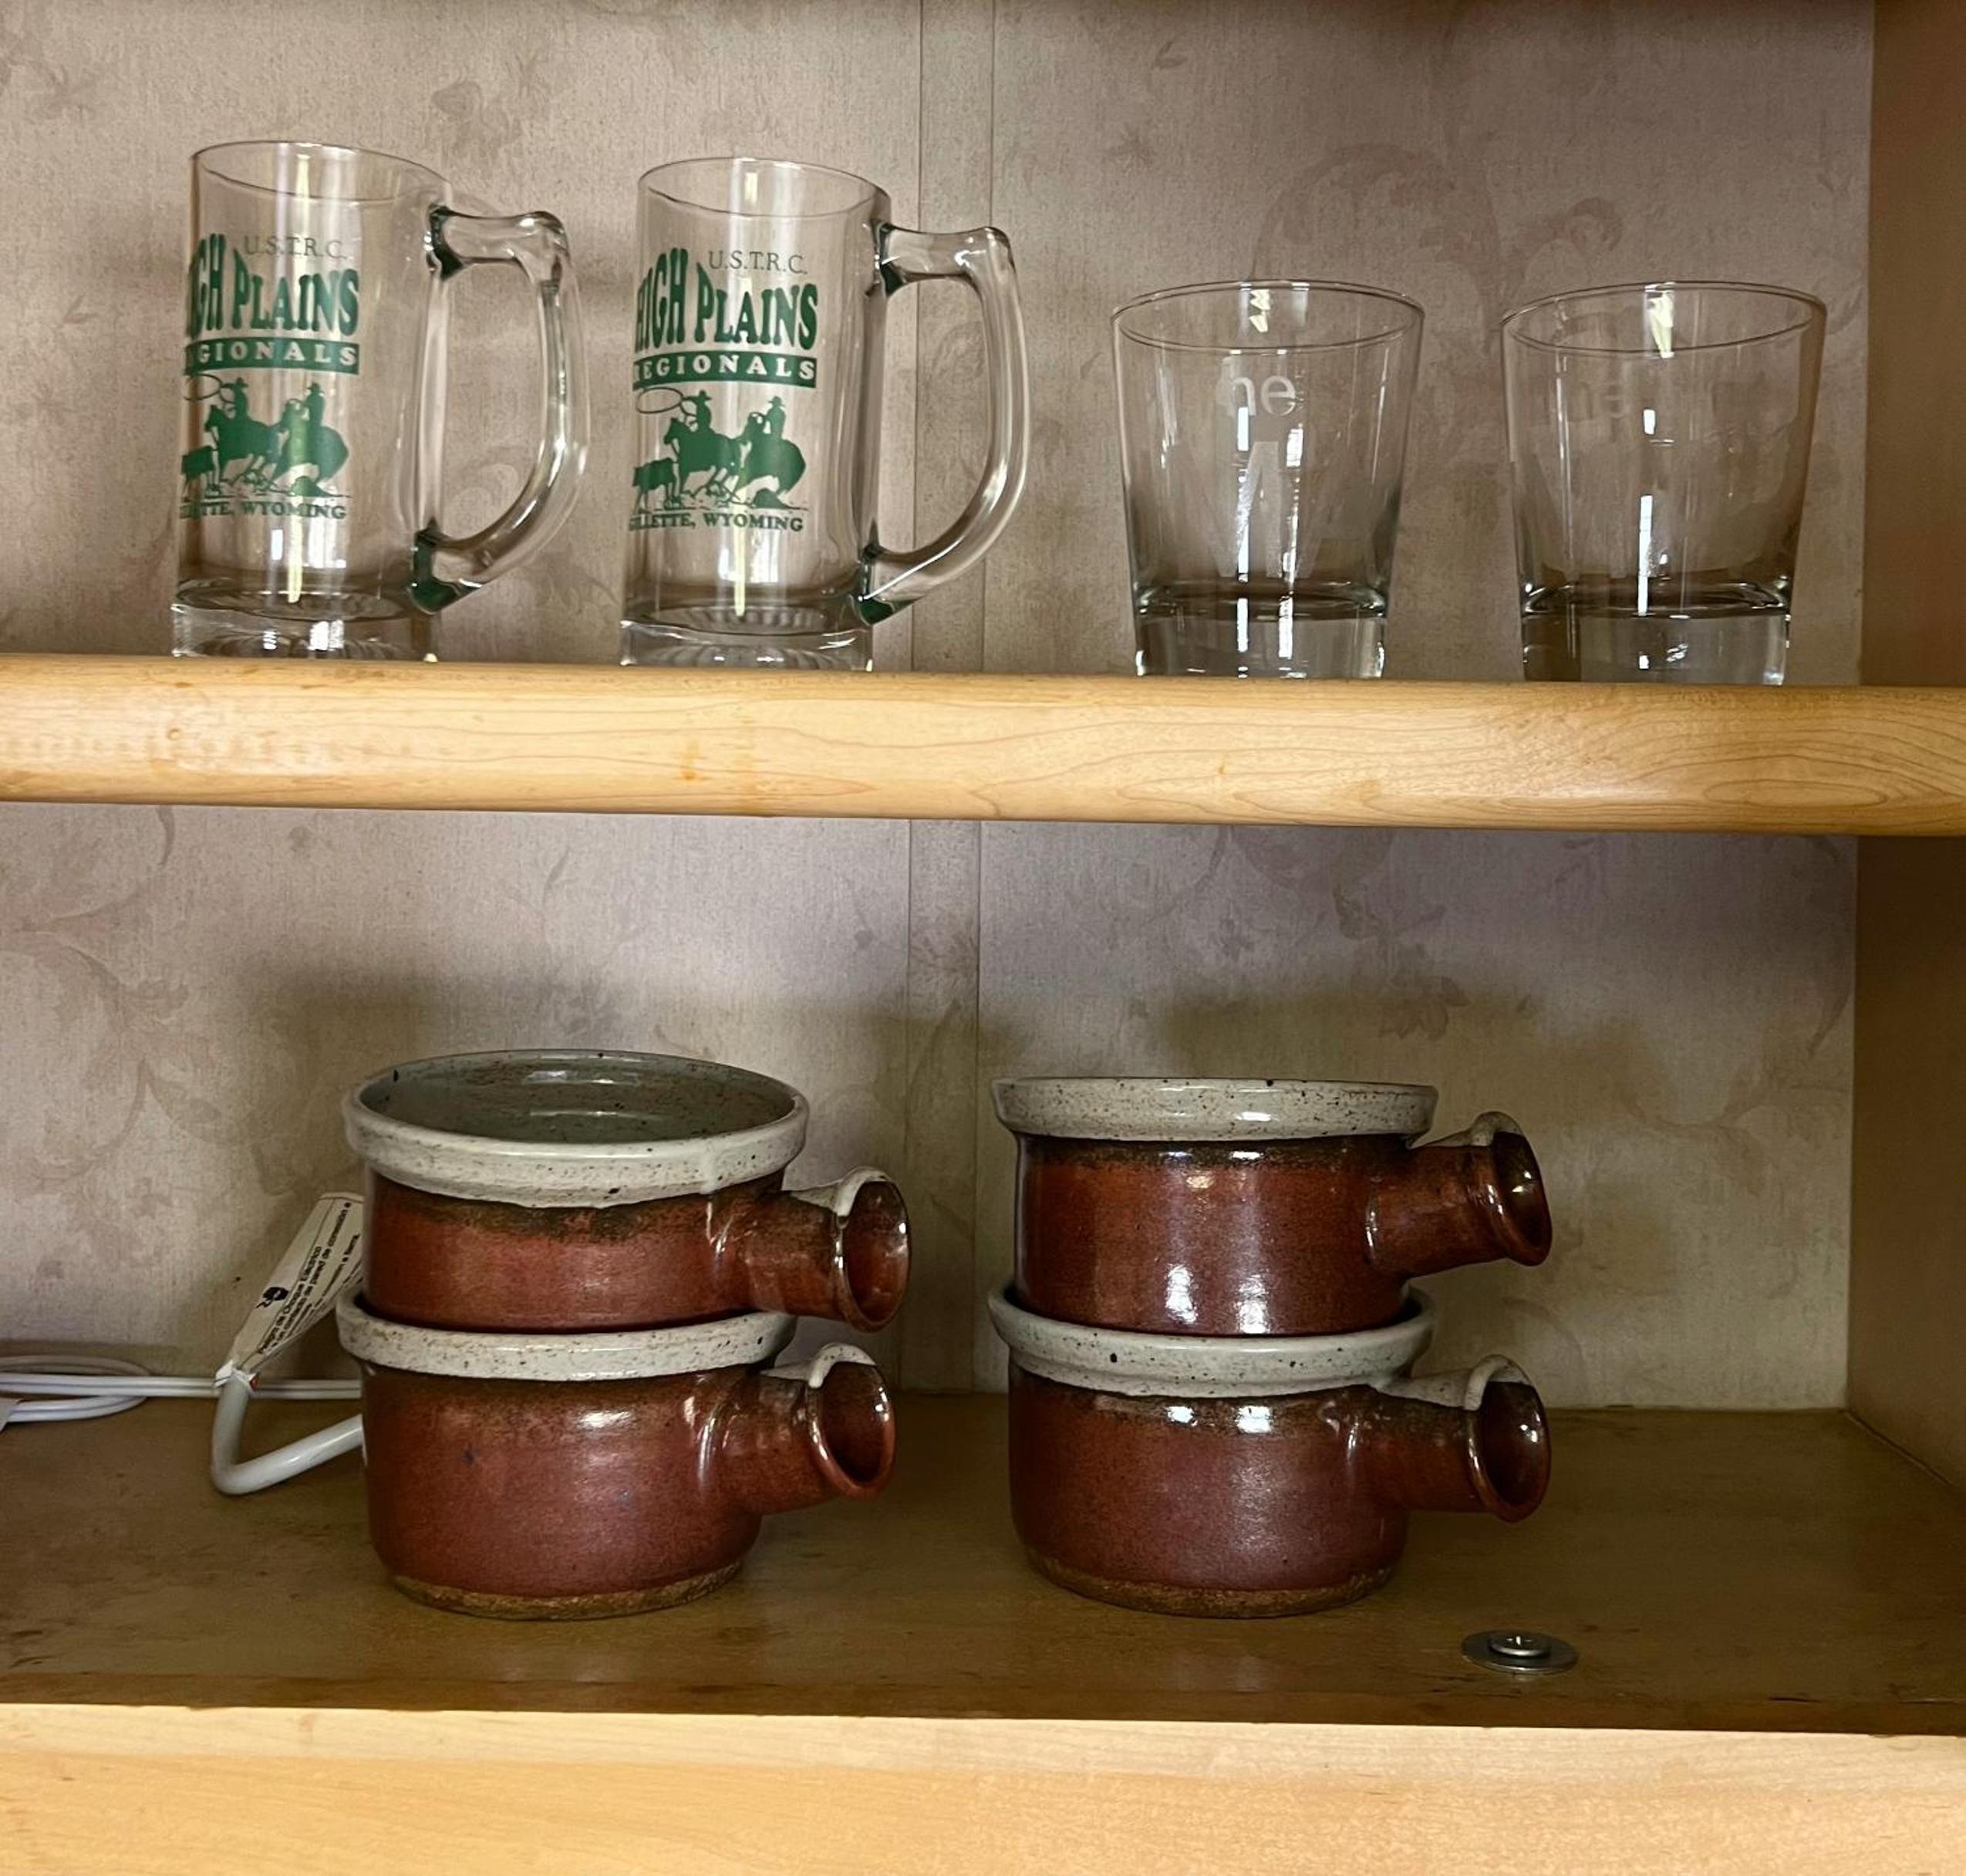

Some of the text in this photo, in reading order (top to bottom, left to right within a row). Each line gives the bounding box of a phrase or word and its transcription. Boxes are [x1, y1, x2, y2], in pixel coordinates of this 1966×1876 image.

[231, 247, 359, 335] PLAINS
[694, 261, 818, 349] PLAINS
[703, 512, 804, 532] WYOMING
